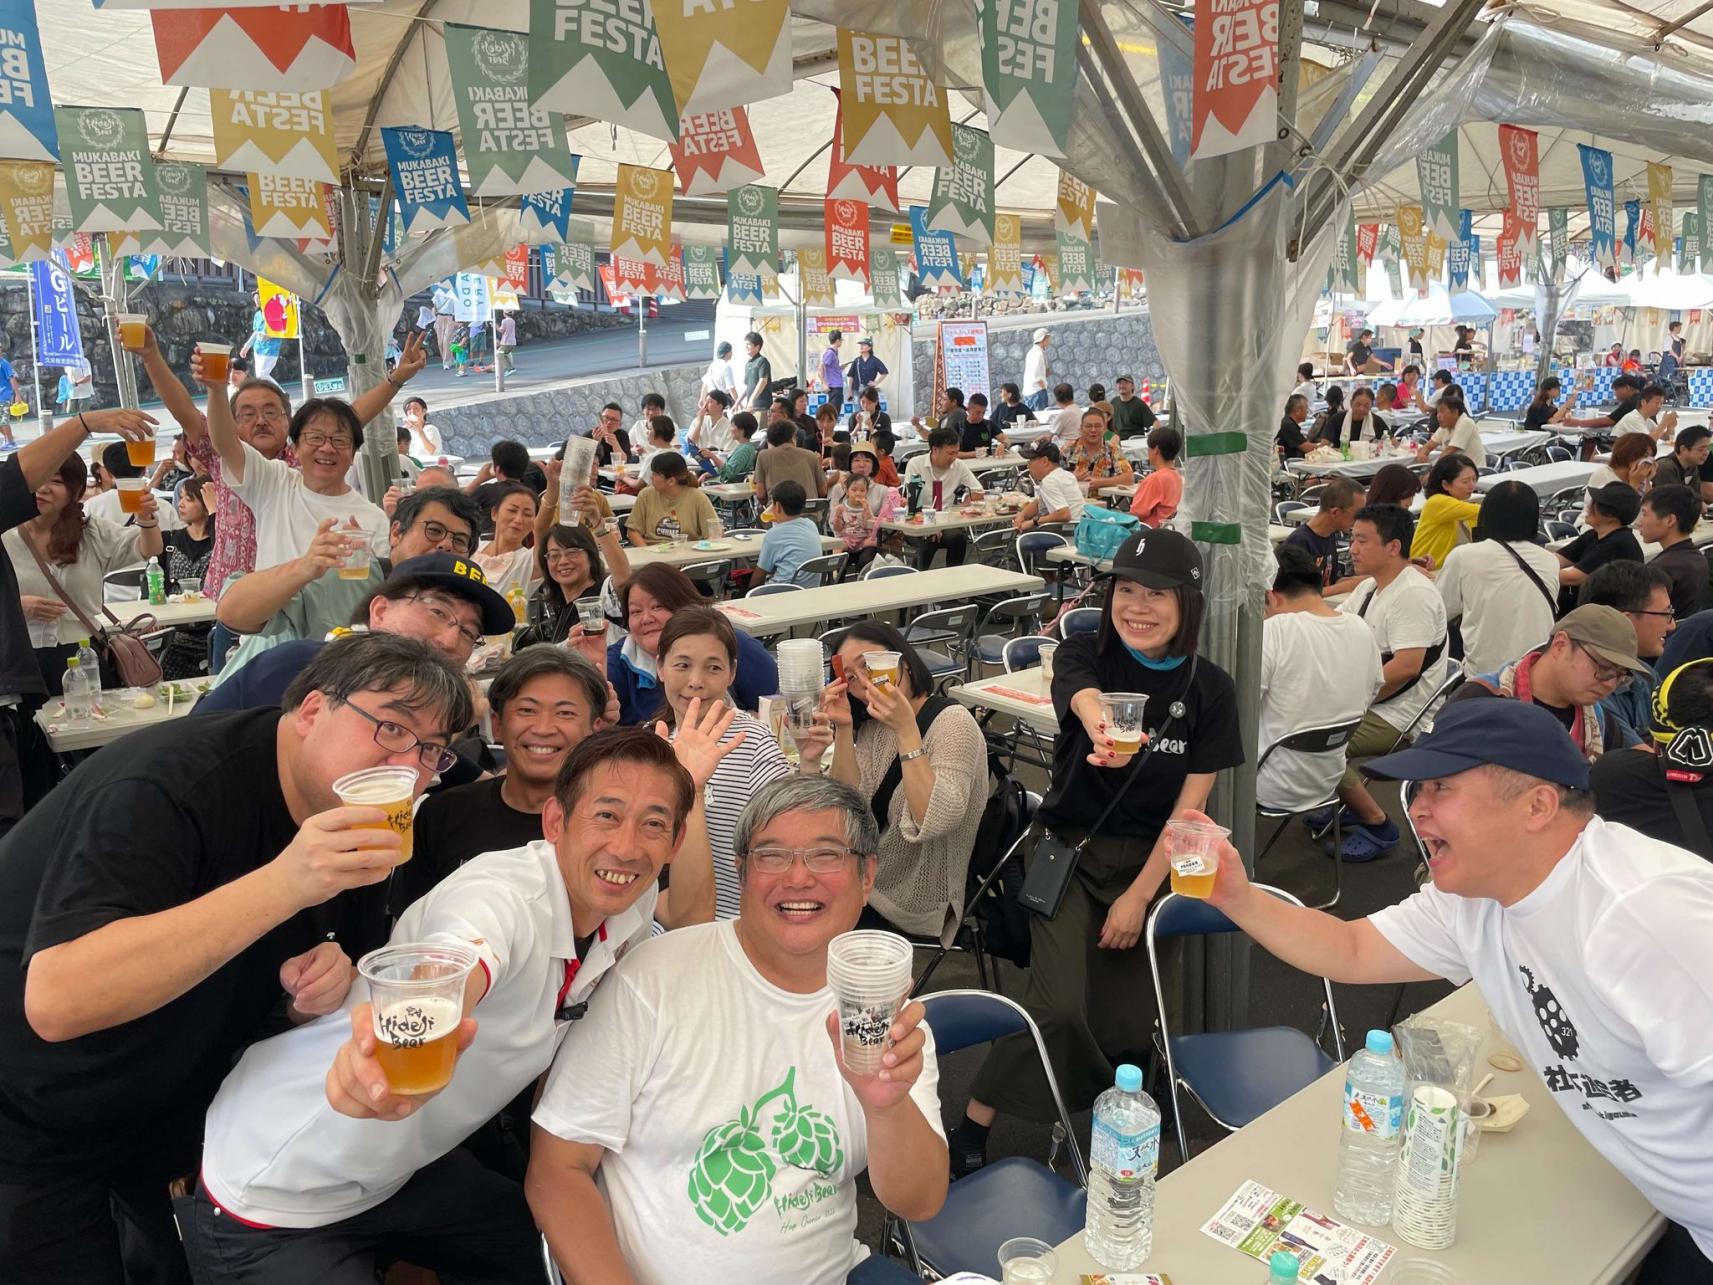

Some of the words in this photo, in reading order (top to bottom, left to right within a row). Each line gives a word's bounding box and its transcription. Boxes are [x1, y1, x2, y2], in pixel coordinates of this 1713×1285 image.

[554, 9, 664, 71] FESTA
[851, 36, 927, 75] BEE
[856, 75, 939, 108] FESTA
[72, 150, 140, 163] MUKABAKI
[398, 155, 450, 172] MUKABAKI
[75, 163, 144, 183] BEER
[400, 167, 454, 190] BEER
[941, 165, 987, 198] BEER
[79, 182, 147, 200] FESTA
[259, 172, 316, 193] BEER
[260, 192, 318, 209] FESTA
[404, 183, 457, 204] FESTA
[938, 180, 987, 213] FESTA
[623, 204, 662, 229] BEER
[733, 215, 771, 227] MUKABAKI
[621, 222, 662, 241] FESTA
[733, 224, 770, 242] BEER
[734, 239, 771, 253] FESTA
[832, 233, 865, 251] BEER
[832, 247, 865, 261] FESTA
[619, 261, 645, 273] BEER
[619, 270, 646, 281] FESTA
[688, 268, 713, 278] BEER
[690, 277, 714, 285] FESTA
[1560, 1026, 1575, 1037] 321
